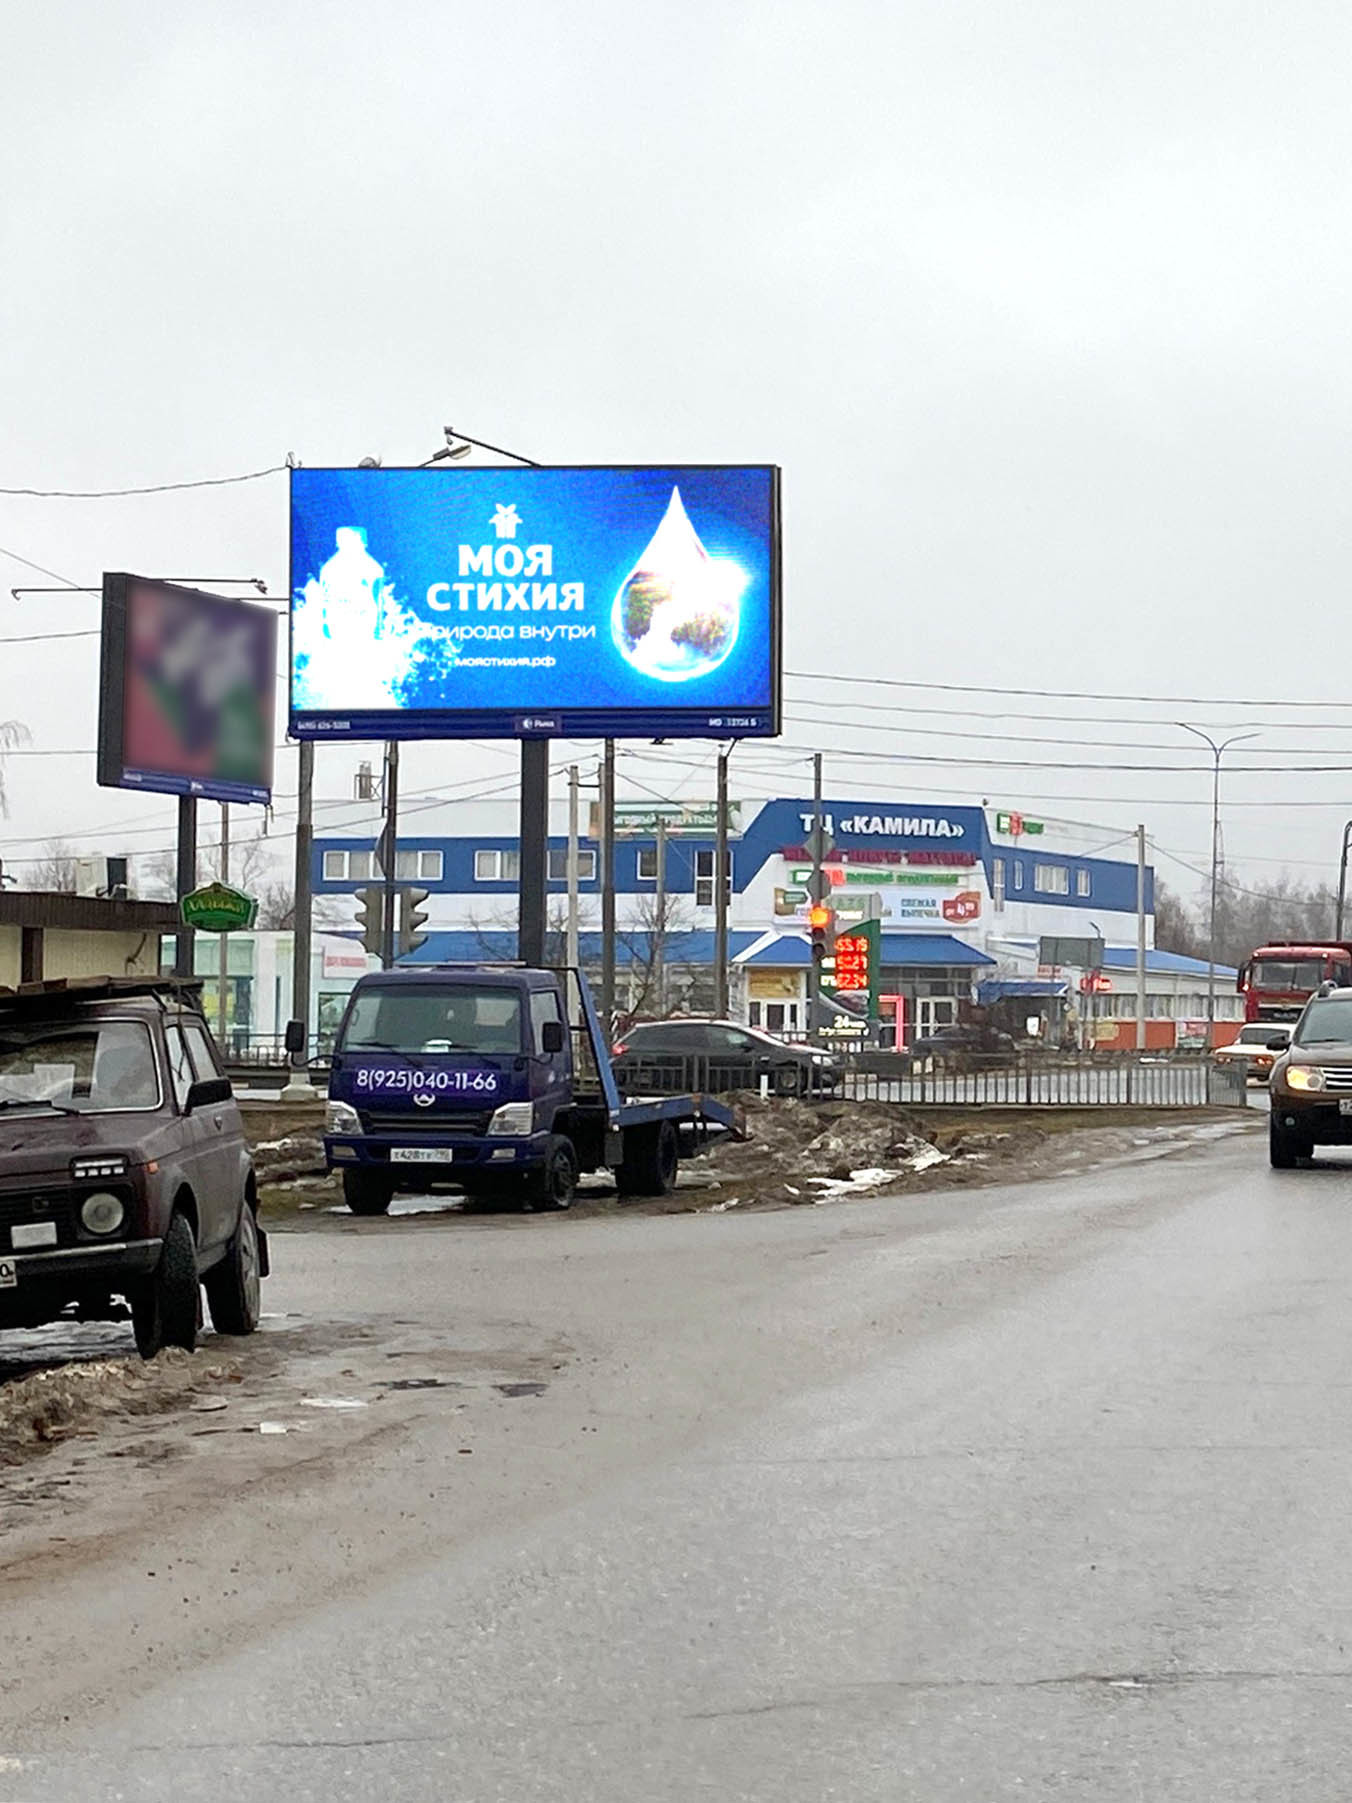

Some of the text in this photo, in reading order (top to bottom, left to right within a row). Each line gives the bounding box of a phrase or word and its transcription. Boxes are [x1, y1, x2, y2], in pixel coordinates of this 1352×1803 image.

[458, 544, 553, 577] МОЯ
[426, 582, 585, 611] СТИХИЯ
[420, 624, 597, 642] рирода внутри
[840, 815, 965, 837] «КАМИЛА»
[356, 1069, 497, 1091] 8(925)040-11-66
